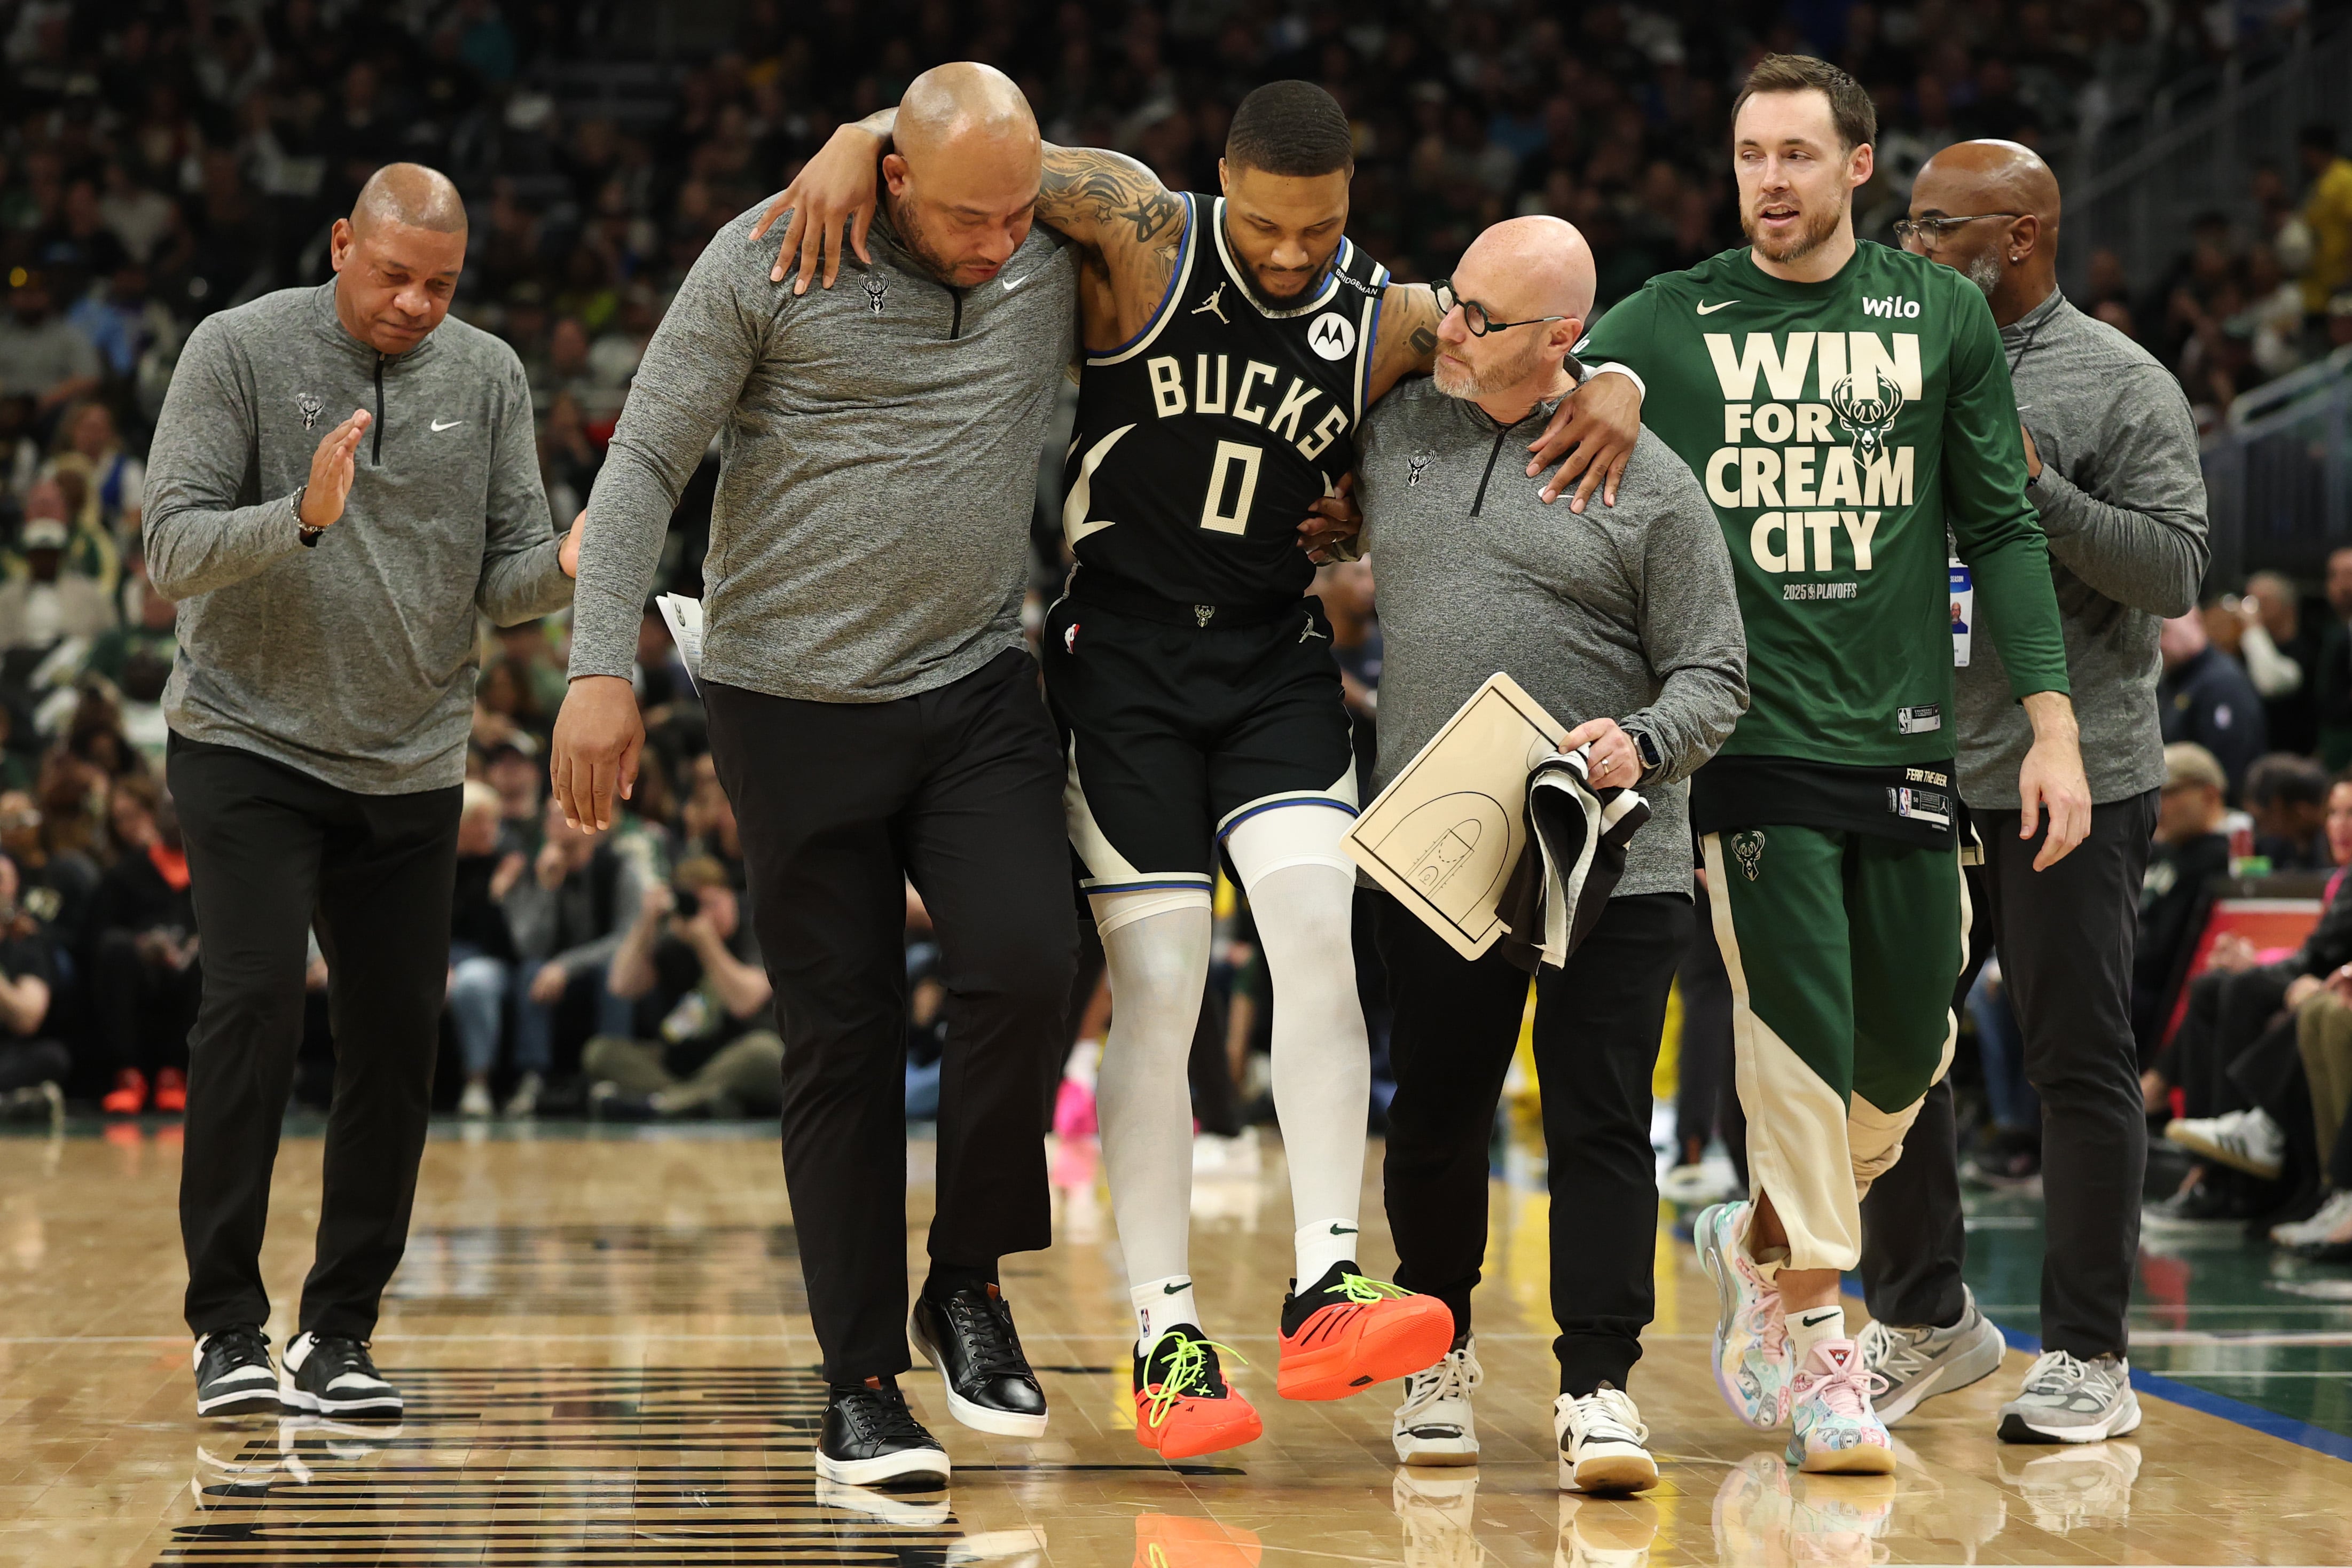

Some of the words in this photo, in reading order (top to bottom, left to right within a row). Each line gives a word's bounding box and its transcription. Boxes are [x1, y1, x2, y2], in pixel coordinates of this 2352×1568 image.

[1335, 268, 1378, 295] BRIDGEMAN
[1862, 295, 1920, 319] wilo
[1703, 331, 1923, 401] WIN
[1146, 353, 1349, 462] BUCKS
[1724, 403, 1836, 443] FOR
[1199, 440, 1264, 536] 0
[1705, 446, 1915, 508] CREAM
[1750, 511, 1881, 574] CITY
[1783, 584, 1807, 600] 2025
[1816, 583, 1857, 599] PLAYOFFS
[1906, 768, 1924, 782] FEAR
[1924, 771, 1935, 784] THE
[1933, 773, 1947, 788] DEER
